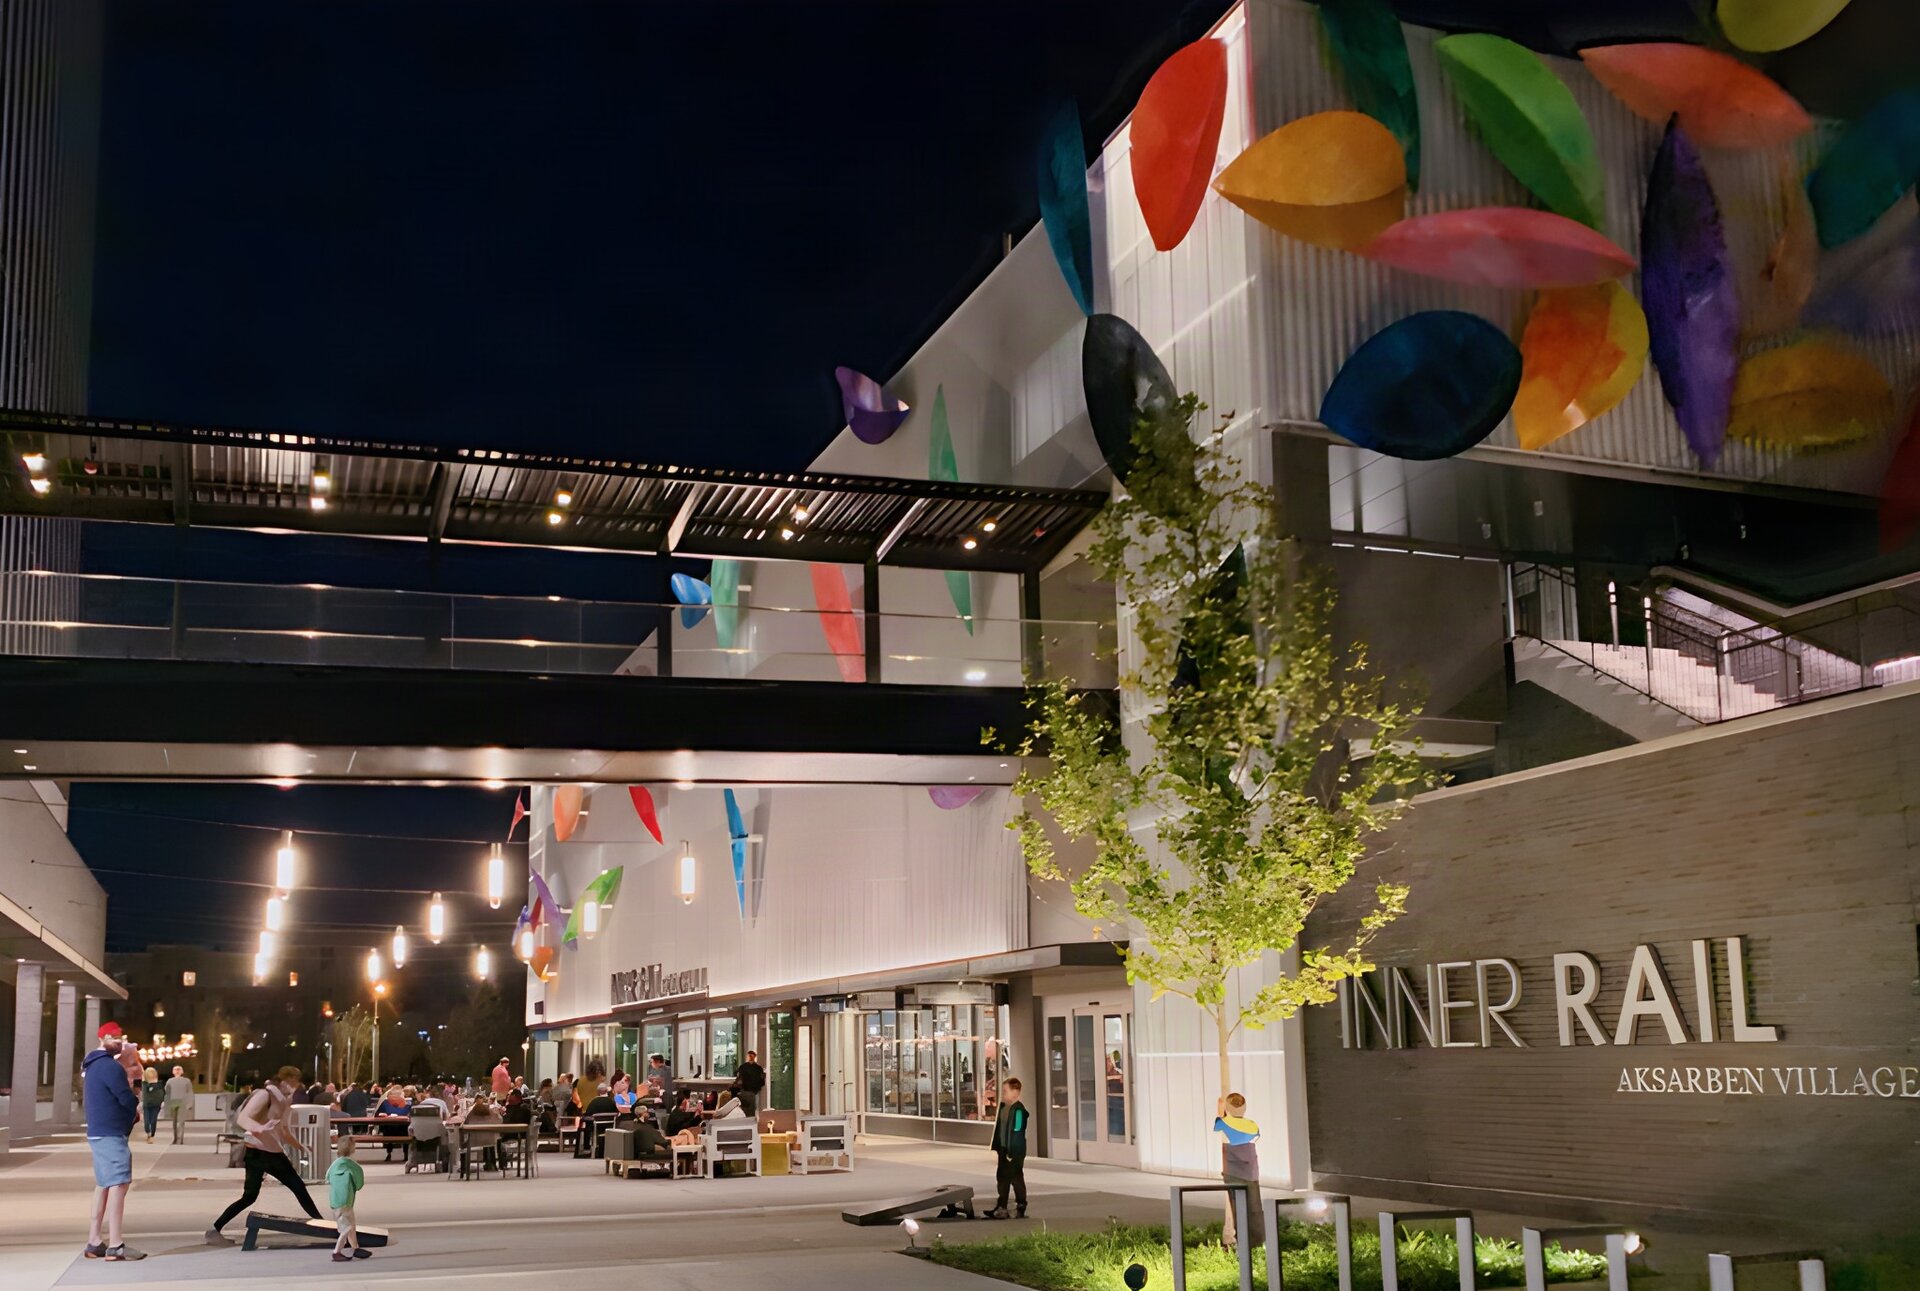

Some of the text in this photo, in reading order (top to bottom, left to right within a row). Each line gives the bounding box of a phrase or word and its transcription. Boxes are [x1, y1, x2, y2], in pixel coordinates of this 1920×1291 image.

[1339, 936, 1779, 1049] INNER RAIL
[1616, 1066, 1920, 1098] AKSARBEN VILLAGE
